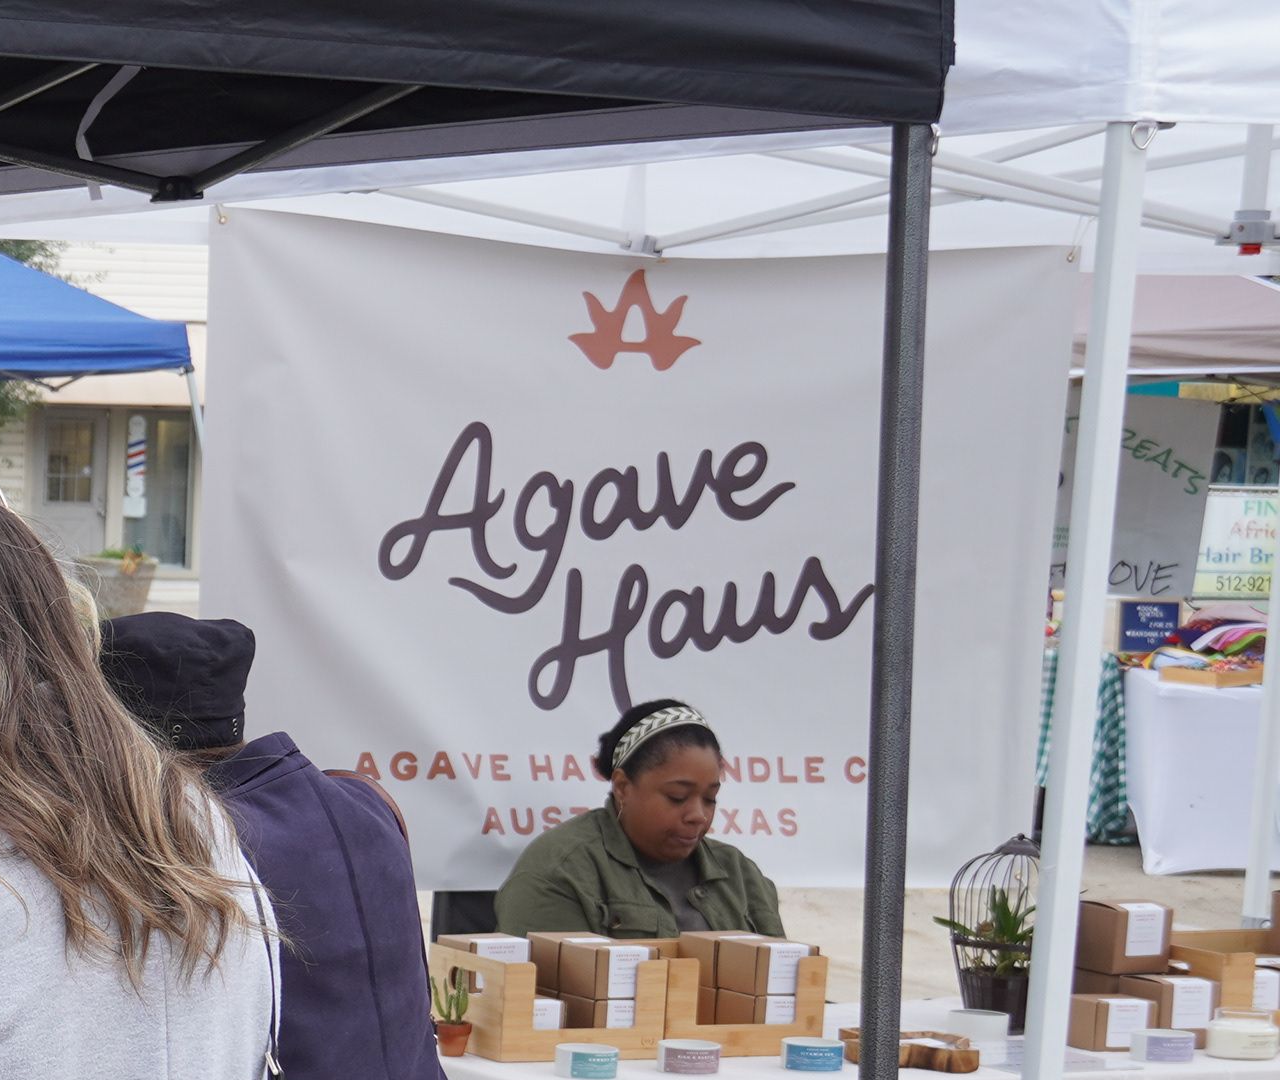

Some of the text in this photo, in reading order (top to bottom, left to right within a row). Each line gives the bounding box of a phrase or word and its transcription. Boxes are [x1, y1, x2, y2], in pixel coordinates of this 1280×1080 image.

[378, 421, 796, 615] Agave
[1216, 575, 1272, 592] 512-921
[528, 556, 876, 714] Haus
[354, 751, 511, 782] AGAVE
[718, 756, 826, 784] NDLE
[844, 757, 867, 784] C
